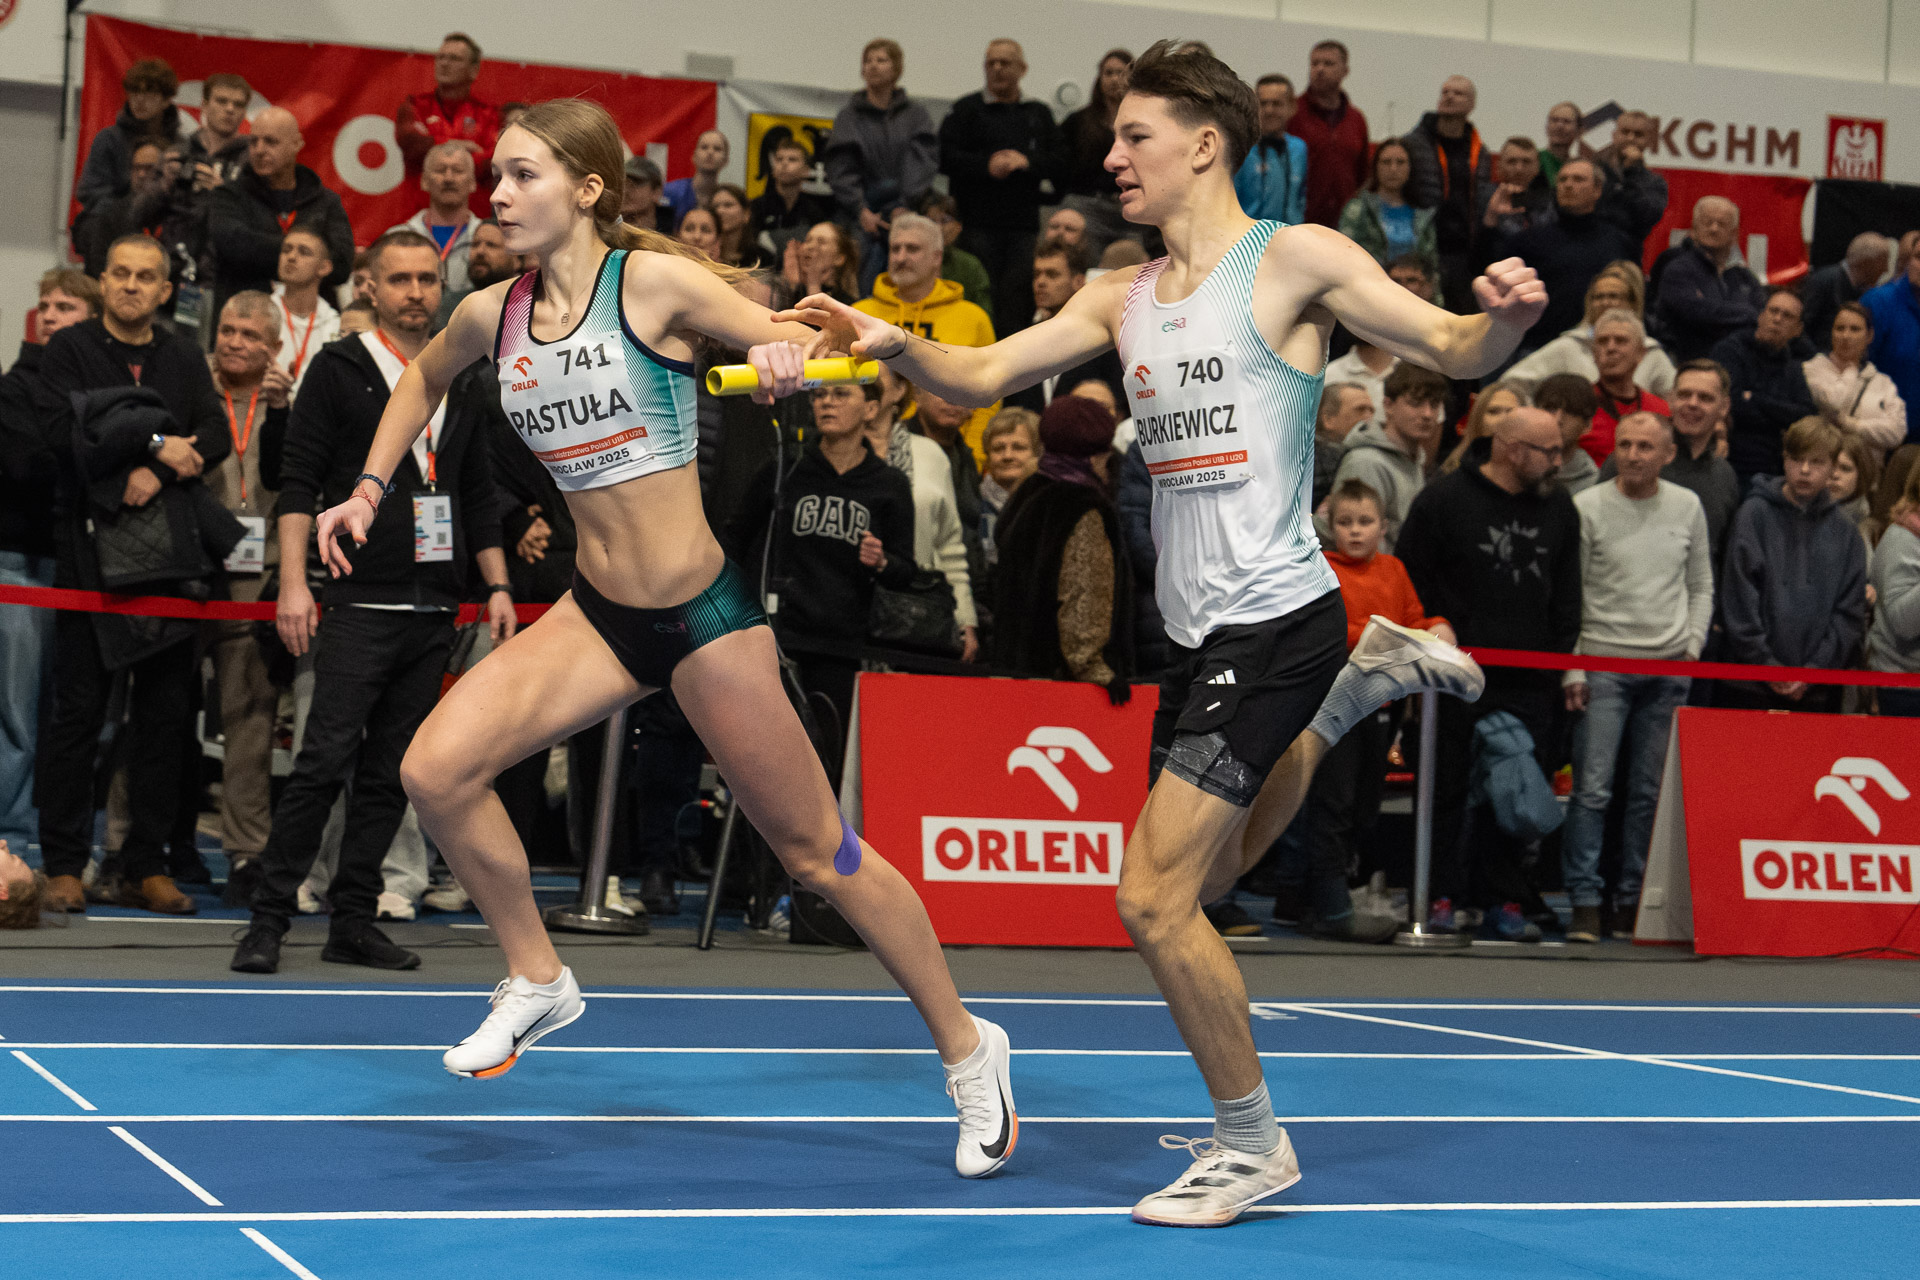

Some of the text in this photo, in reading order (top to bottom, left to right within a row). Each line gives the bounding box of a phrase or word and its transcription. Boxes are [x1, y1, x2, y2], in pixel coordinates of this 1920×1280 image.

[1649, 116, 1800, 168] KGHM
[1162, 317, 1187, 333] esa
[556, 343, 611, 376] 741
[1177, 356, 1224, 387] 740
[511, 378, 539, 392] ORLEN
[1136, 388, 1156, 400] ORLEN
[510, 388, 633, 437] PASTUŁA
[1136, 404, 1238, 447] BURKIEWICZ
[590, 439, 612, 452] Polski
[612, 435, 625, 445] U18
[629, 429, 644, 438] U20
[597, 447, 630, 466] 2025
[1192, 457, 1212, 467] Polski
[1212, 455, 1225, 464] U18
[1230, 453, 1244, 461] U20
[1196, 469, 1226, 483] 2025
[792, 494, 871, 546] GAP
[934, 827, 1111, 874] ORLEN
[1753, 849, 1912, 893] ORLEN
